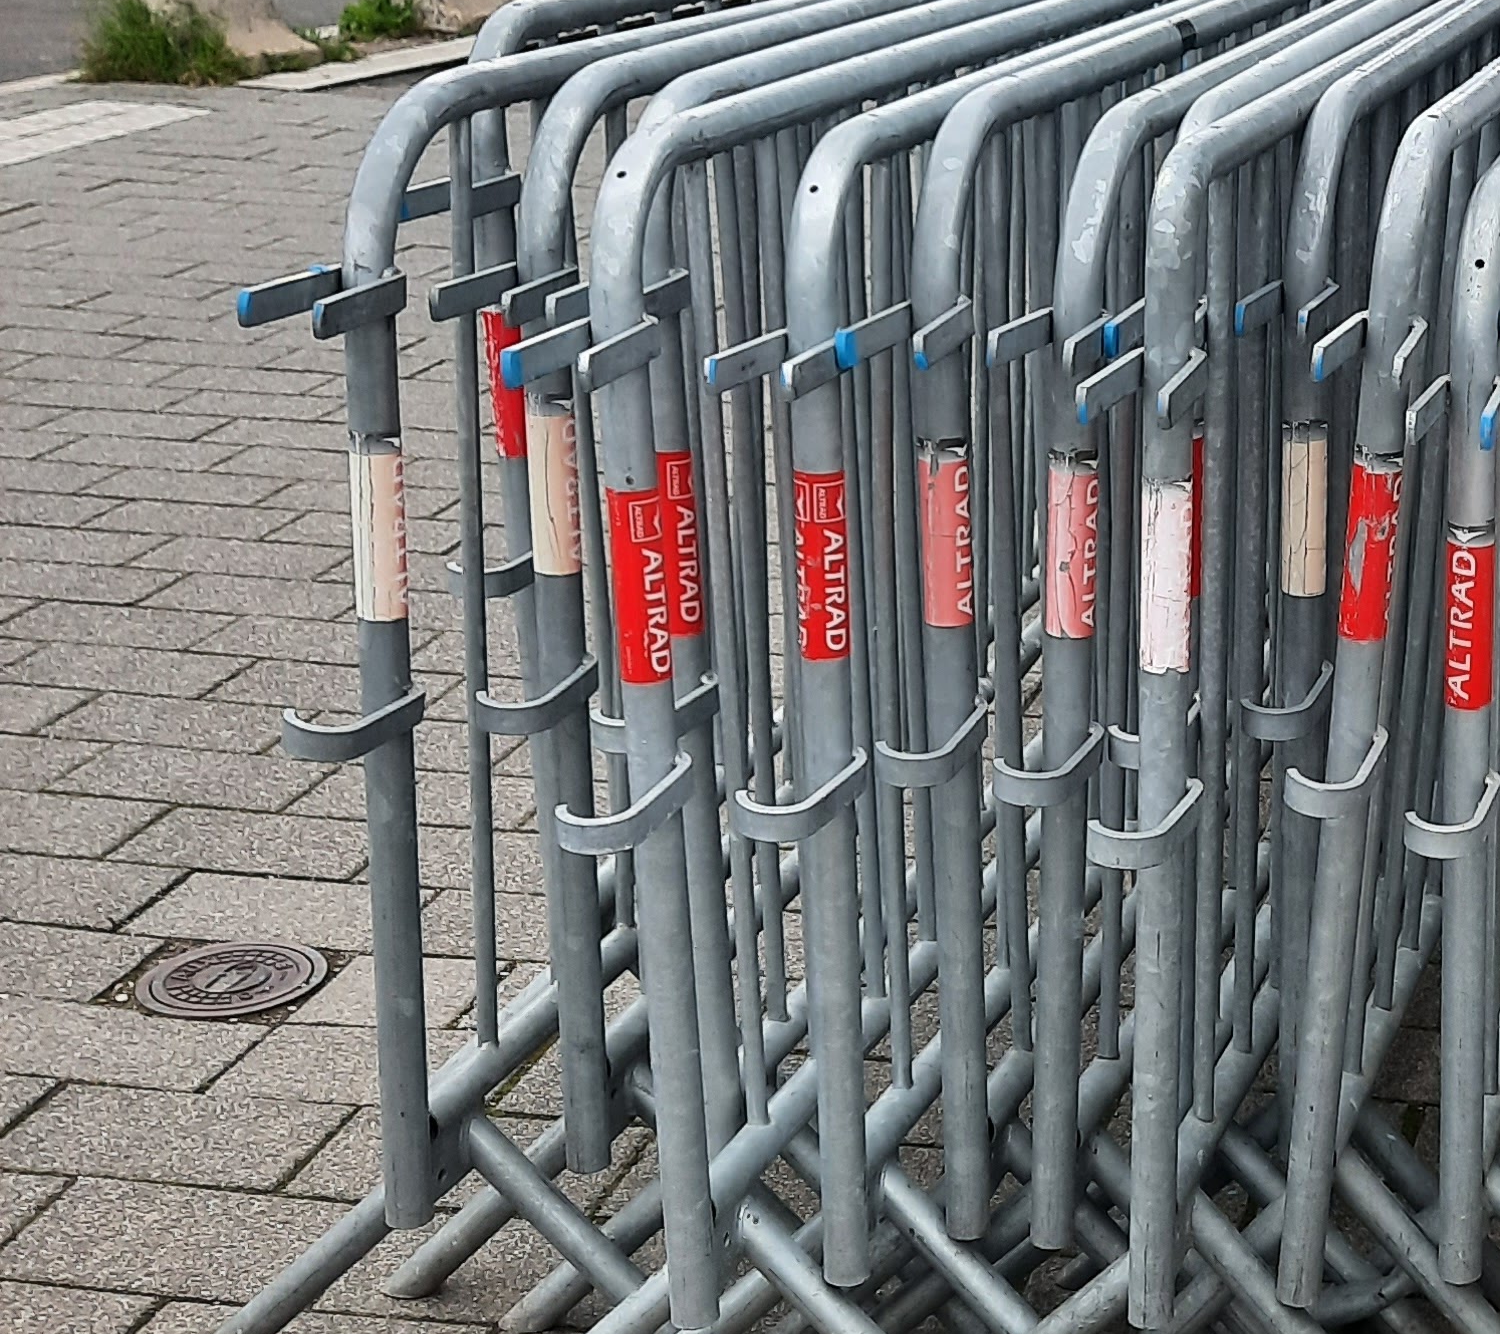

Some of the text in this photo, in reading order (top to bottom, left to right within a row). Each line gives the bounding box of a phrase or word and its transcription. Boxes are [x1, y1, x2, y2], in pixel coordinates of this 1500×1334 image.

[676, 504, 702, 624] ALTRAD
[823, 528, 847, 651] ALTRAD
[954, 466, 975, 616] ALTRAD
[641, 547, 672, 674] ALTRAD
[1448, 549, 1477, 701] ALTRAD
